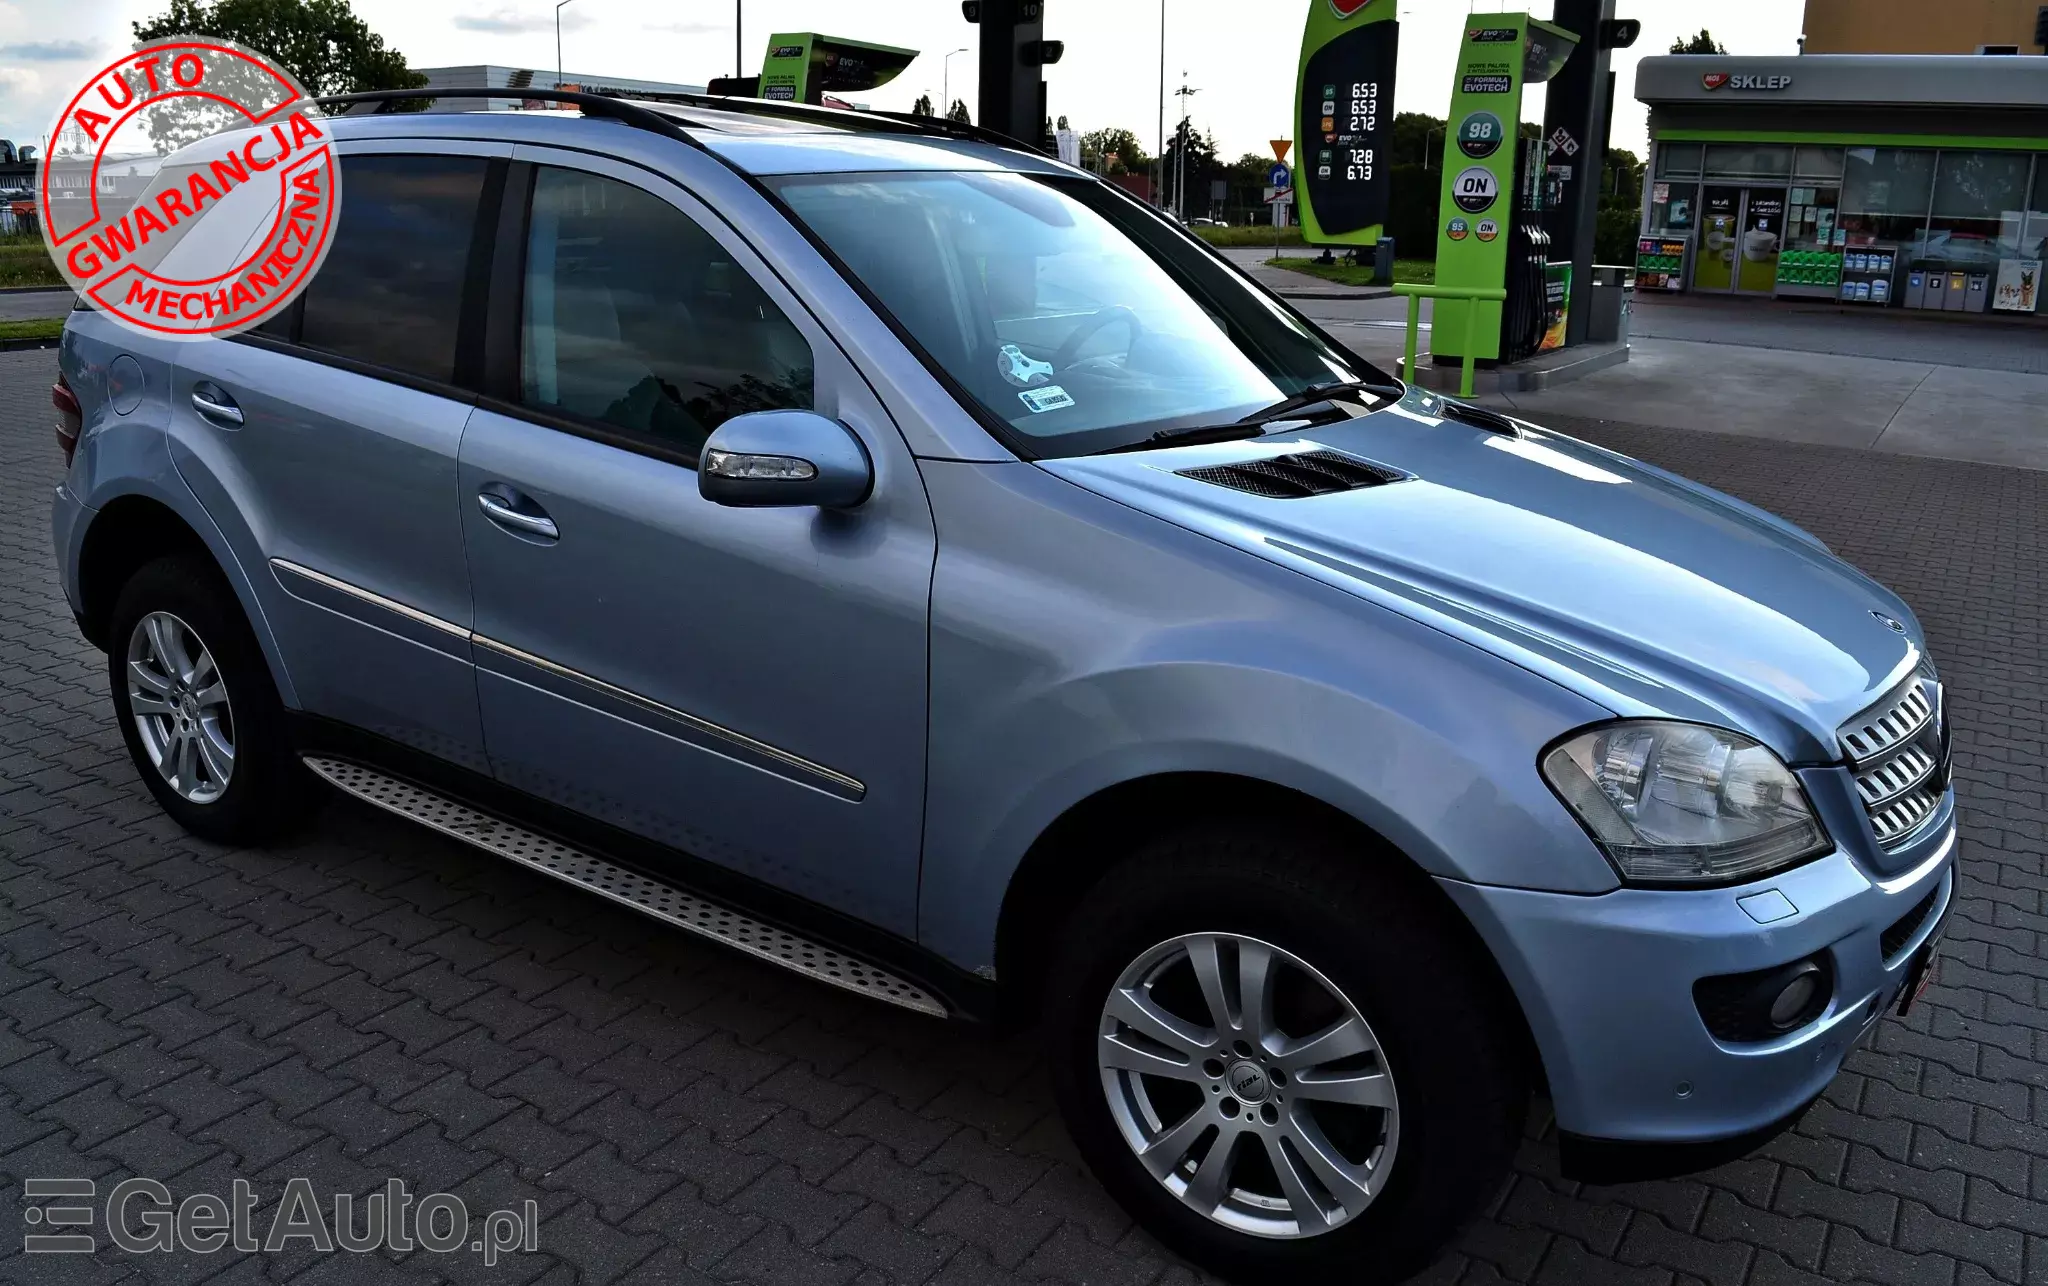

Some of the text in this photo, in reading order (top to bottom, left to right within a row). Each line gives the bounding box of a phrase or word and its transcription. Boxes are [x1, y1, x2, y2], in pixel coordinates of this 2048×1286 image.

[968, 6, 976, 17] 9
[1023, 4, 1038, 16] 10
[1616, 25, 1628, 40] 4
[1045, 46, 1053, 58] 2
[1463, 83, 1508, 92] EVOTECH
[1730, 75, 1792, 89] SKLEP
[1351, 83, 1378, 99] 6.53
[1350, 99, 1377, 115] 6.53
[1349, 116, 1376, 131] 2.72
[1468, 122, 1492, 139] 98
[1346, 165, 1373, 181] 6.73
[1463, 177, 1488, 193] ON
[1451, 222, 1464, 231] 95
[1480, 223, 1494, 232] ON
